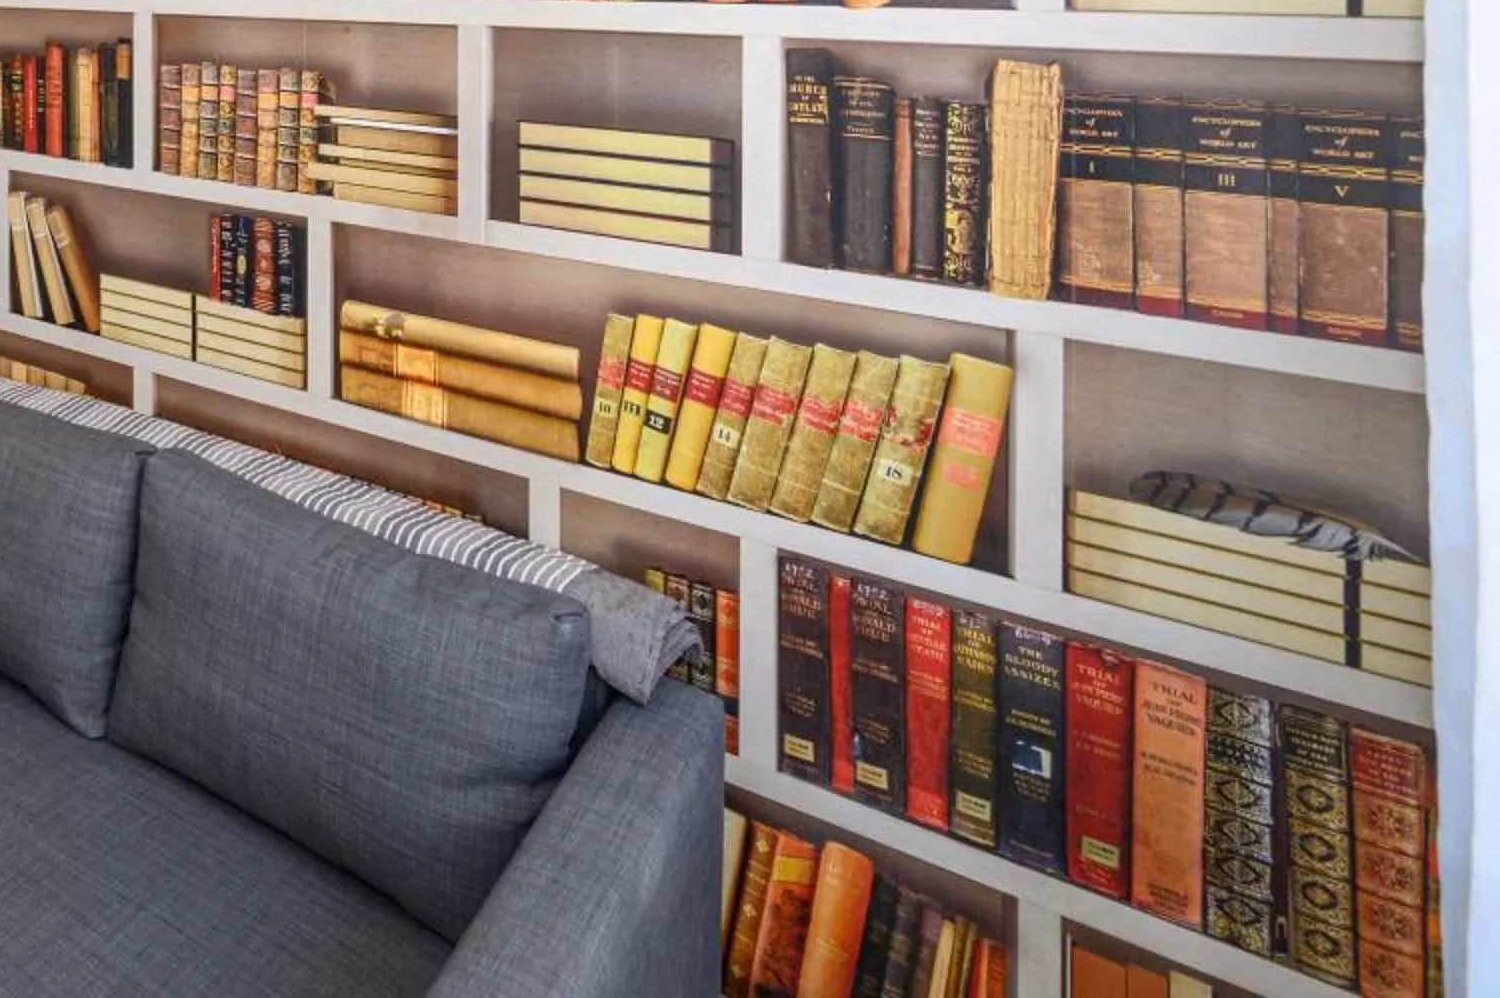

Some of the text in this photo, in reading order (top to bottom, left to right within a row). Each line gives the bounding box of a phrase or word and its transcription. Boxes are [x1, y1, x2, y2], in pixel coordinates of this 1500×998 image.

[1334, 136, 1349, 149] of
[1217, 173, 1236, 186] III
[1333, 184, 1349, 198] V
[648, 414, 665, 429] 12
[715, 428, 732, 443] 14
[885, 465, 903, 480] 18
[1018, 645, 1043, 661] THE
[1005, 653, 1060, 677] BLOODY
[1076, 664, 1120, 684] TRIAL
[1149, 682, 1198, 705] TRIAL
